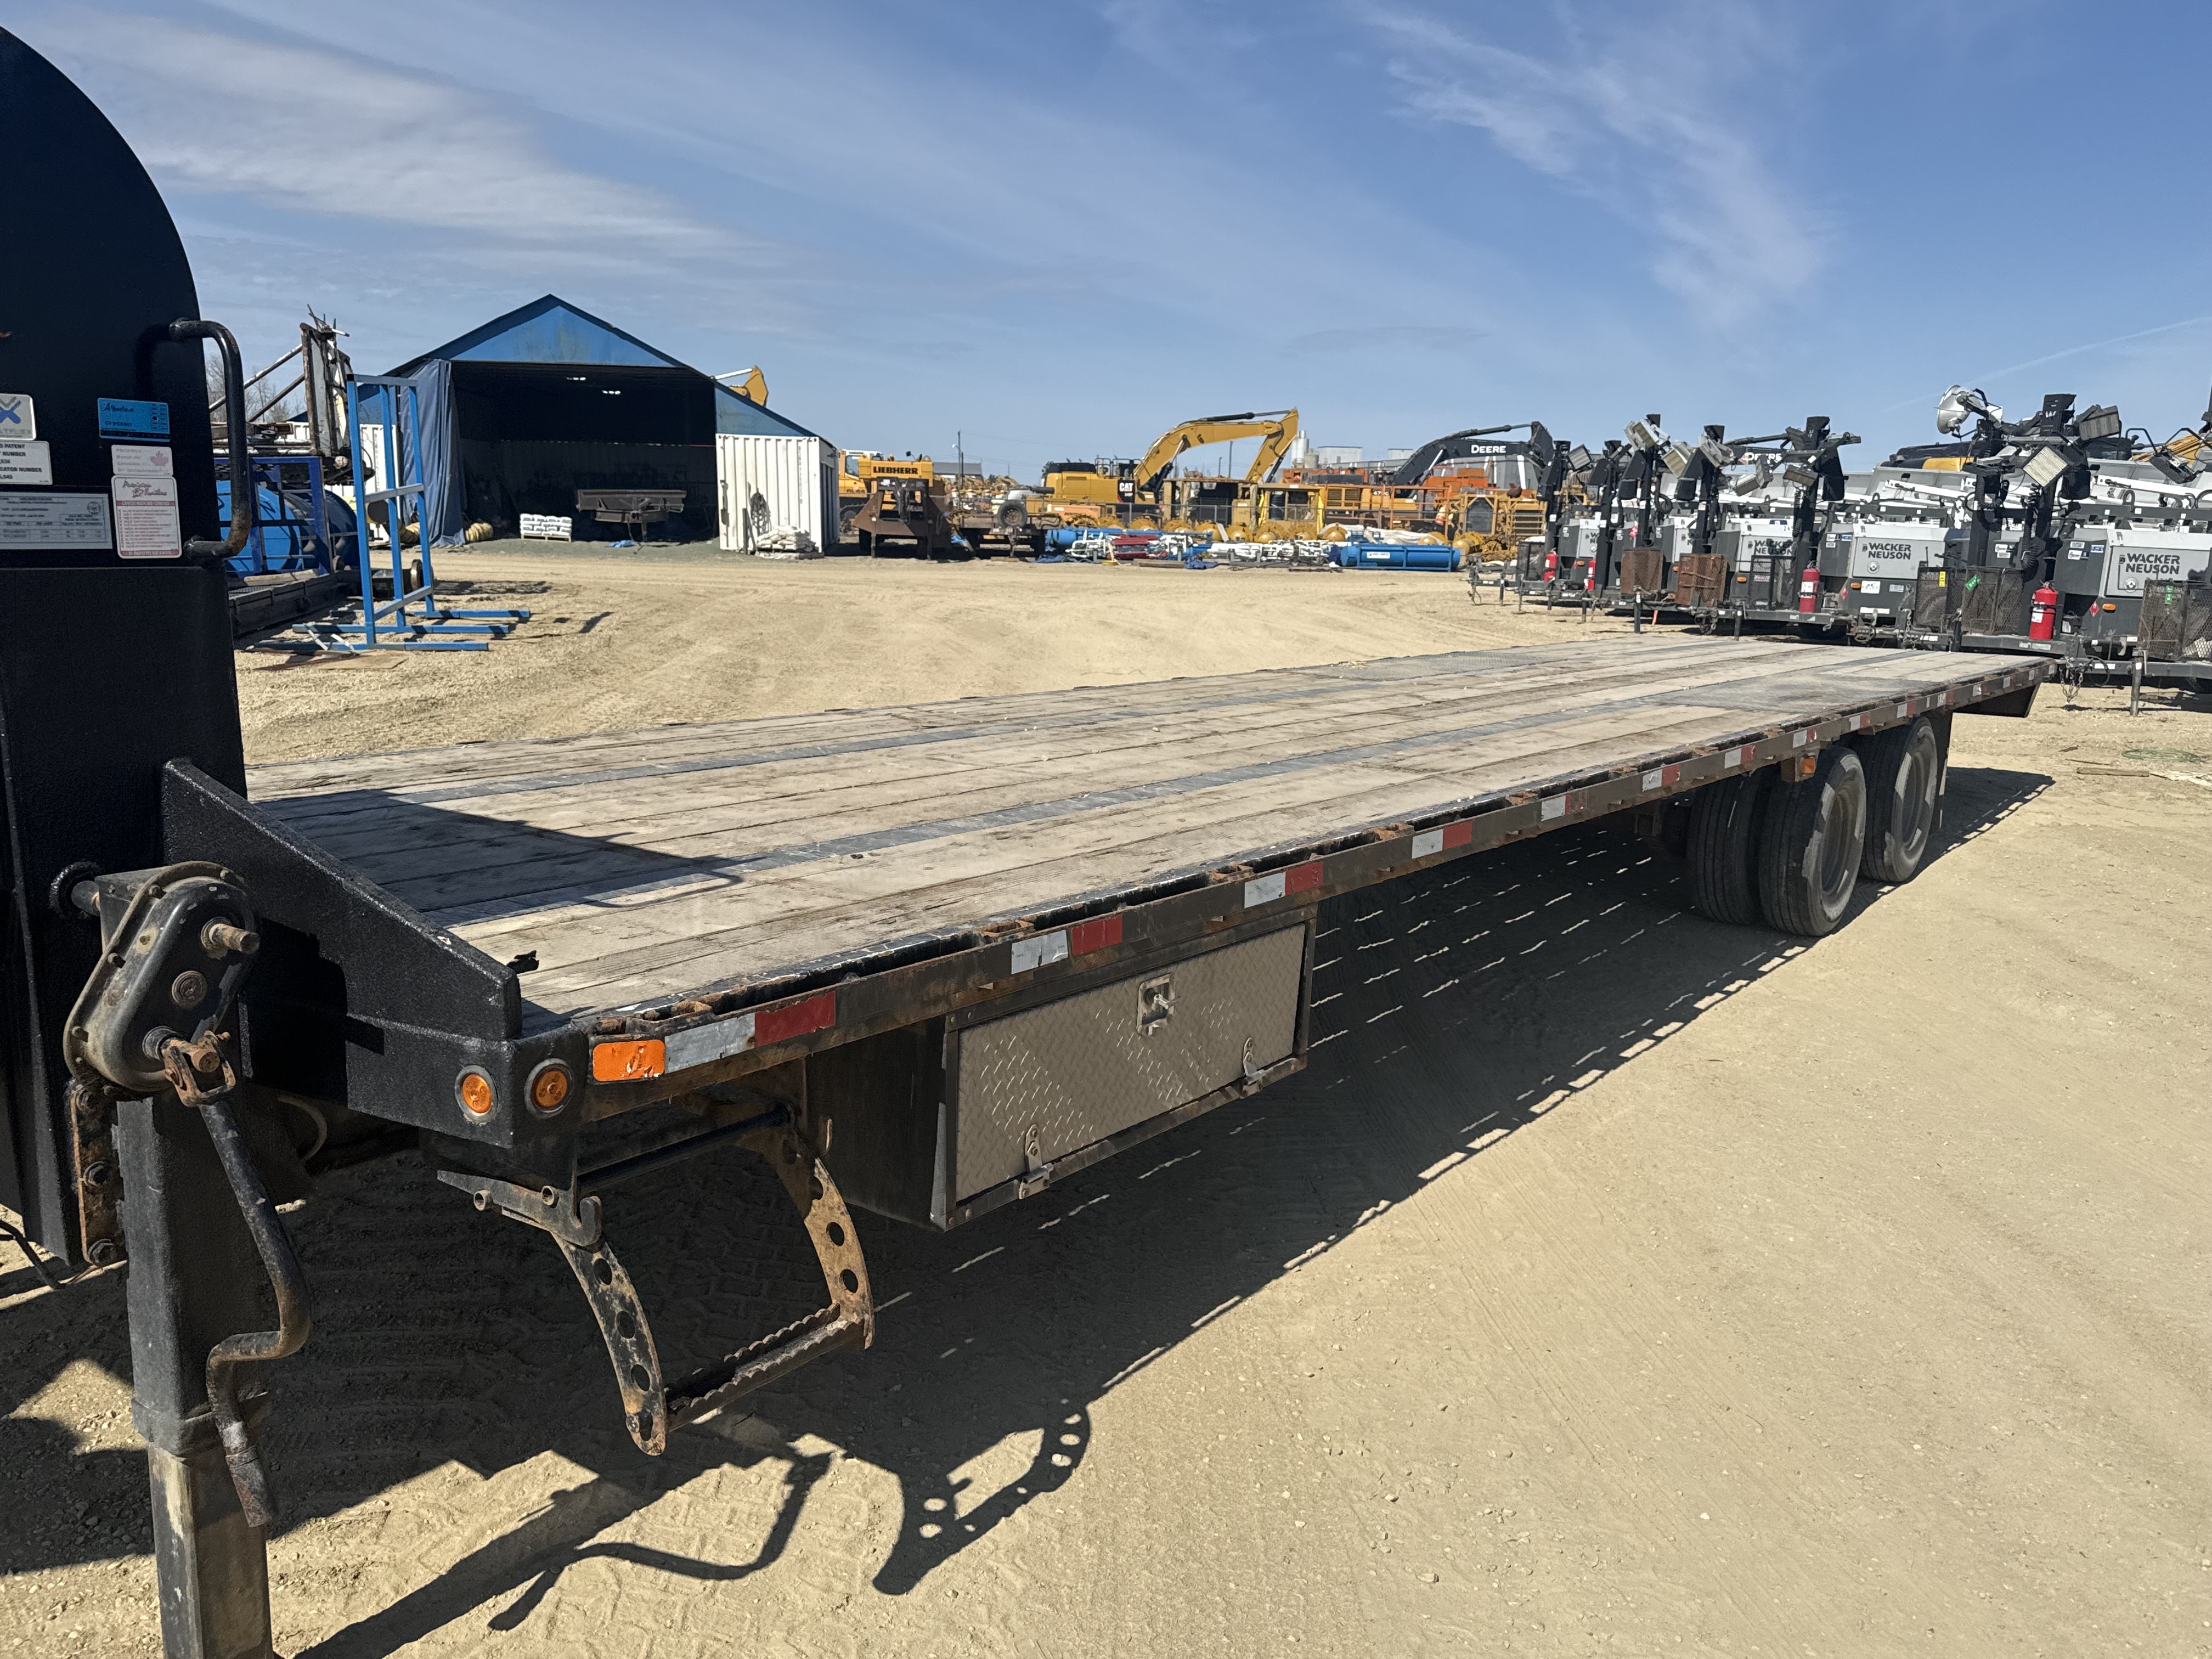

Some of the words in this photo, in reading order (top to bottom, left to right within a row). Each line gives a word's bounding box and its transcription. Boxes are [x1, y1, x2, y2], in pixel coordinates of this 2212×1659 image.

[1471, 444, 1506, 454] DEERE
[1119, 482, 1133, 492] CAT
[1869, 543, 1911, 552] WACKER
[1868, 551, 1911, 560] NEUSON
[2126, 553, 2180, 565] WACKER
[2125, 563, 2180, 574] NEUSON
